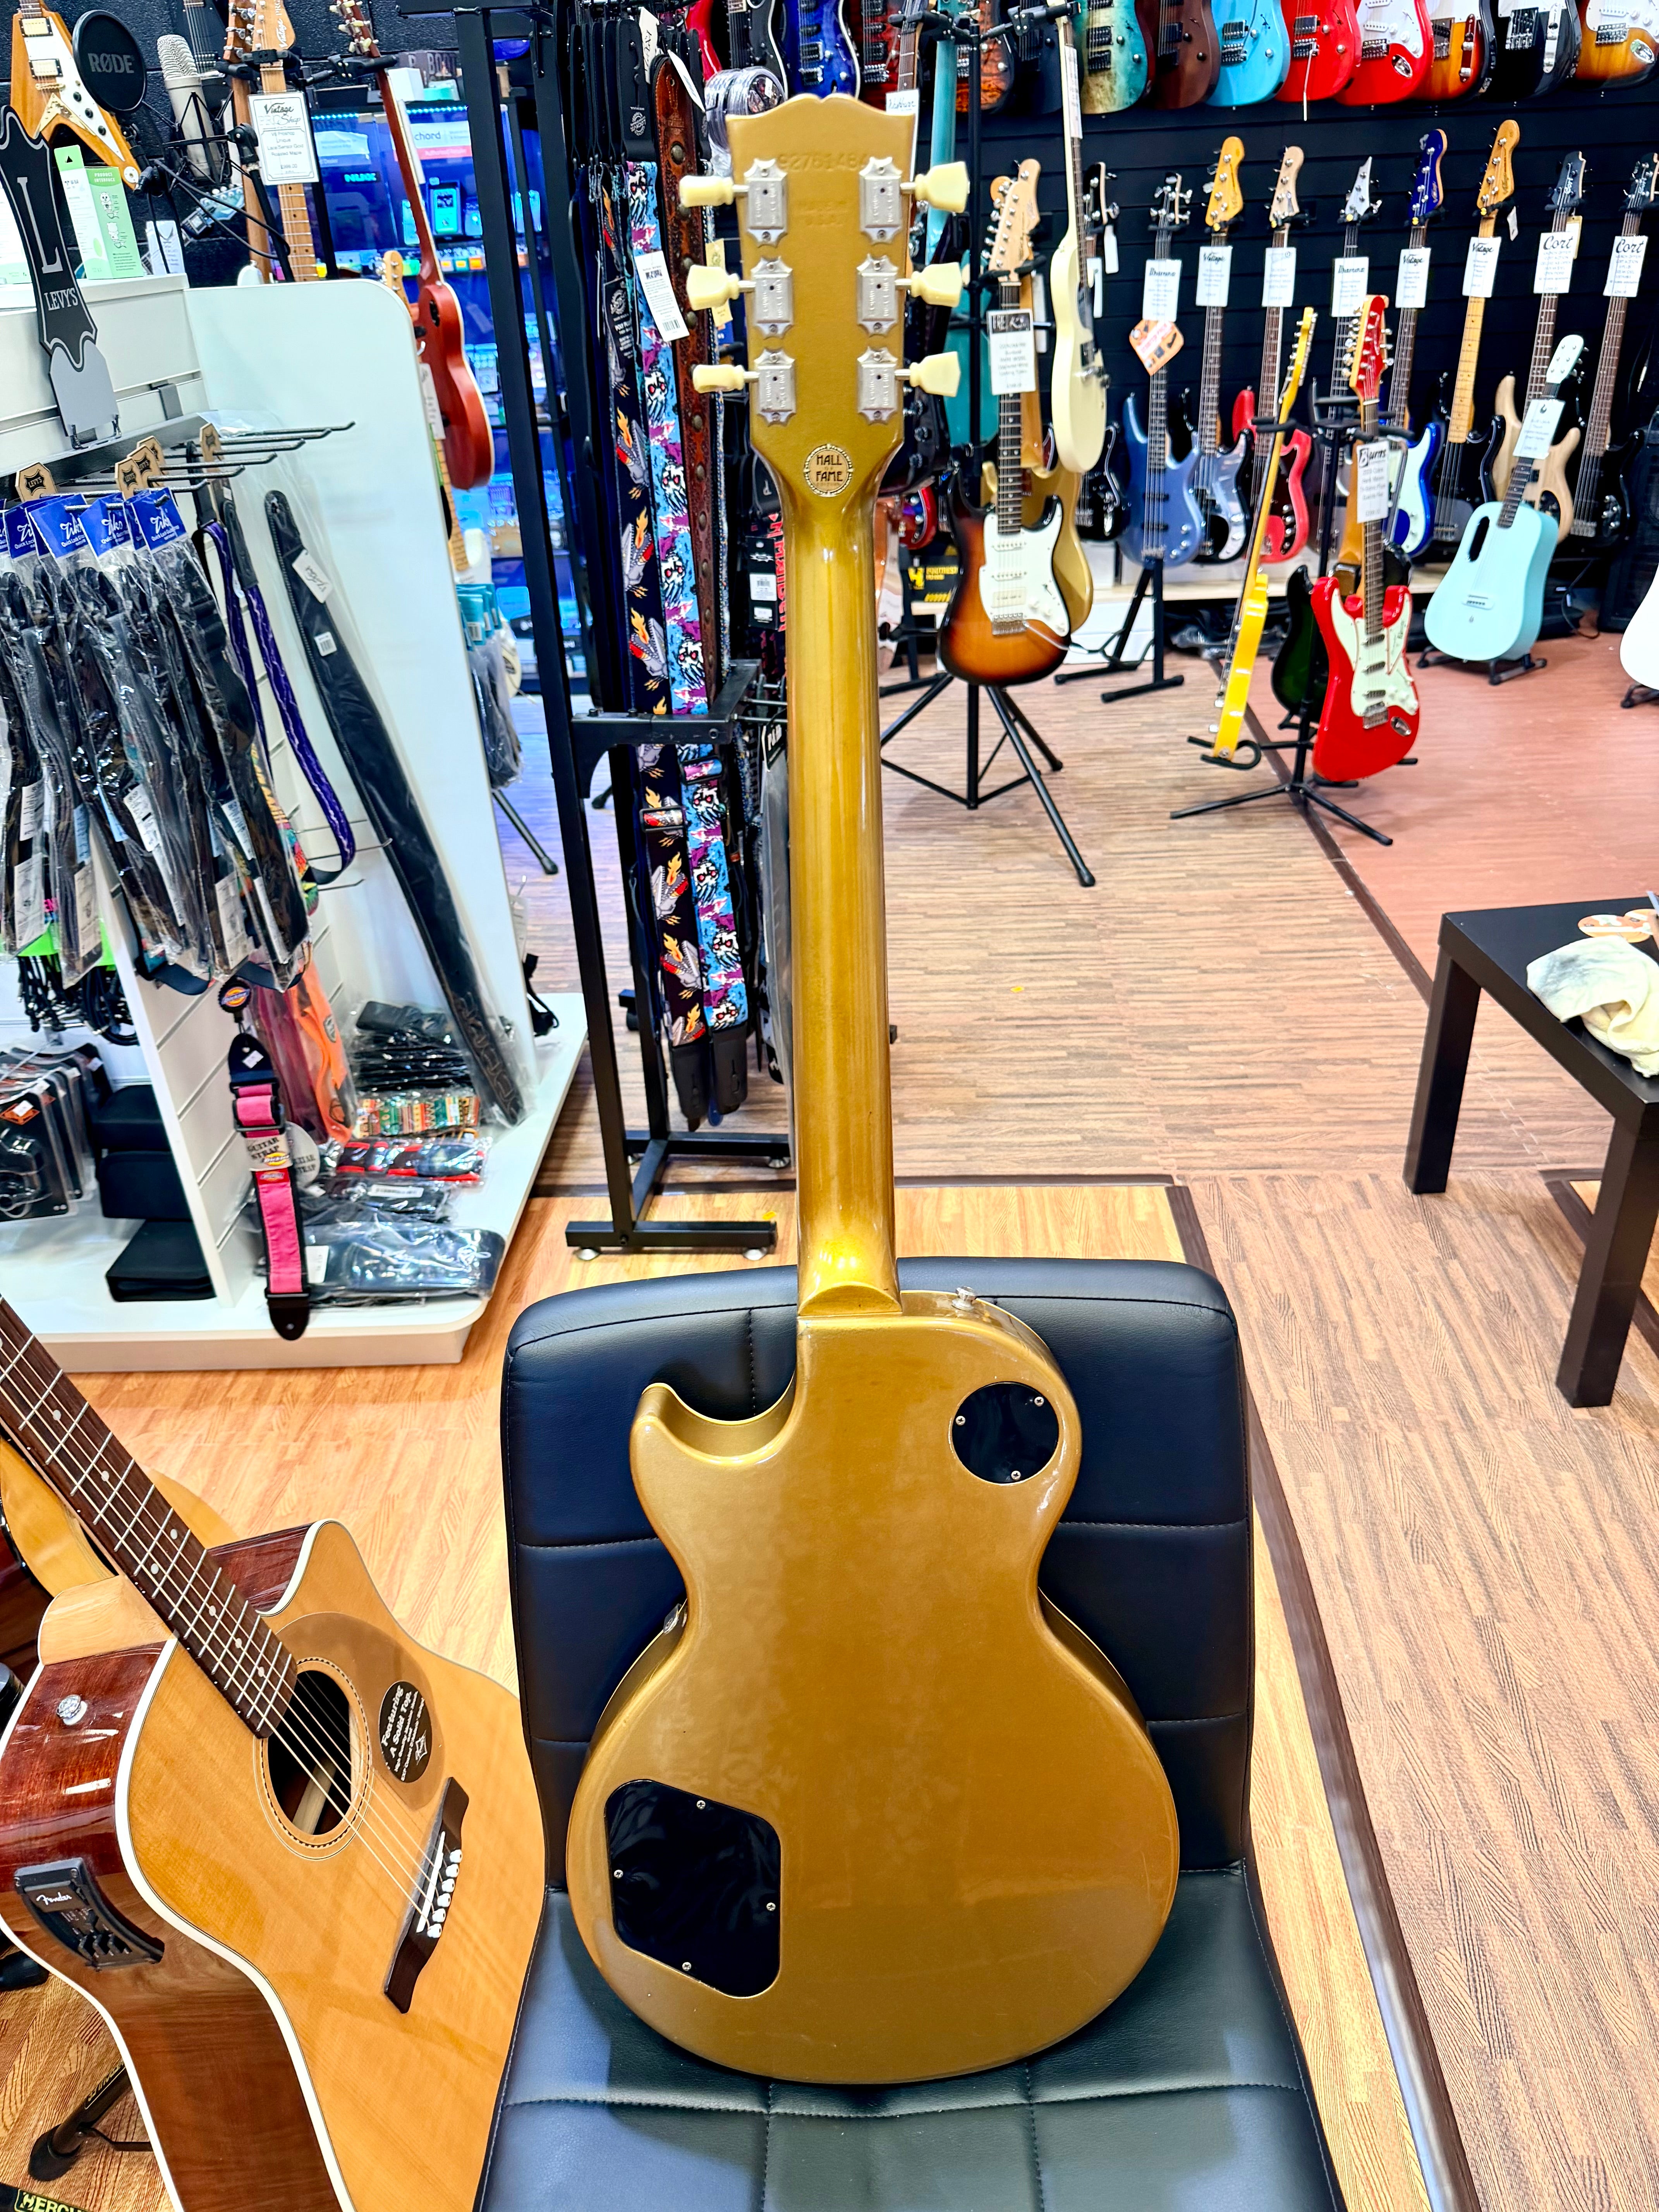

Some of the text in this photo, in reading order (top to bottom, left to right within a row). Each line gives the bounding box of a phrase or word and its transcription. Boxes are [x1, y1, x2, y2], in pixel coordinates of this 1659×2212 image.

[88, 53, 134, 73] RØDE
[264, 102, 294, 116] Vintage
[414, 131, 441, 141] chord
[17, 177, 64, 273] L
[1543, 235, 1573, 250] Cort
[1615, 239, 1644, 253] Cort
[44, 287, 78, 311] LEVY'S
[817, 455, 842, 465] HALL
[27, 477, 43, 488] LEVY'S
[816, 471, 843, 481] FAME
[17, 523, 33, 542] Zi
[247, 1137, 279, 1152] GUITAR
[251, 1145, 279, 1159] STRAP
[381, 1685, 404, 1747] Featuring
[390, 1691, 412, 1758] A Solid Top.
[36, 1892, 72, 1906] Fender
